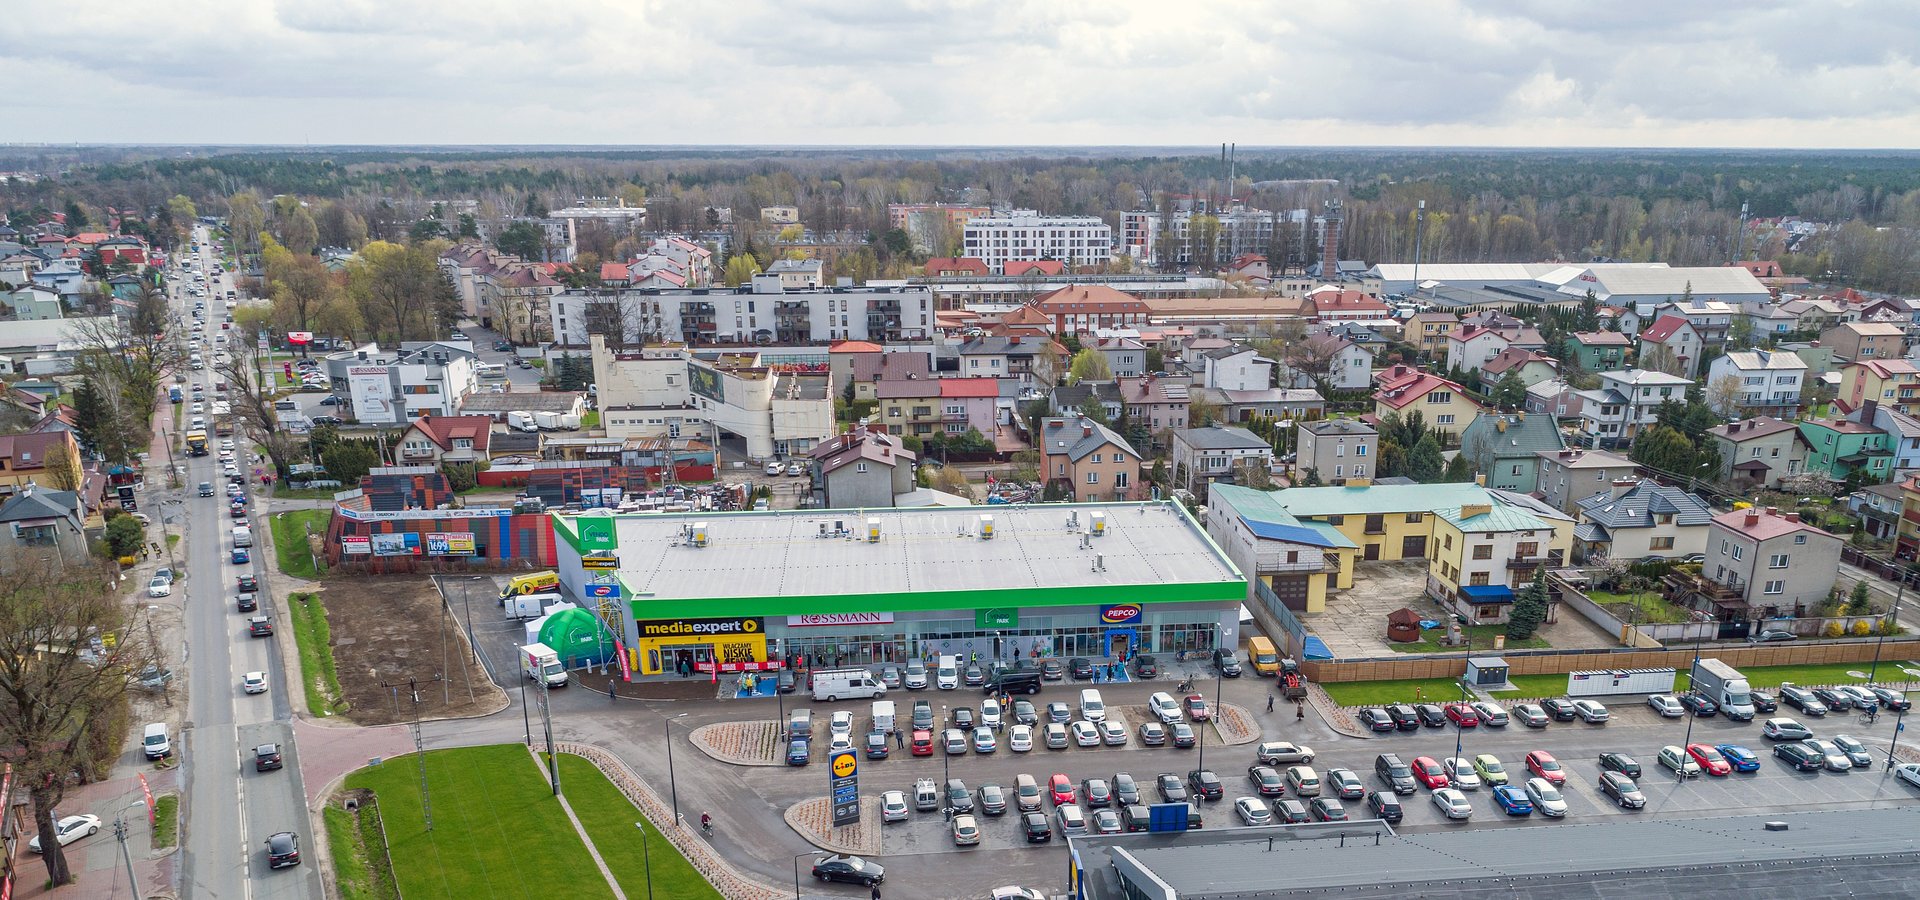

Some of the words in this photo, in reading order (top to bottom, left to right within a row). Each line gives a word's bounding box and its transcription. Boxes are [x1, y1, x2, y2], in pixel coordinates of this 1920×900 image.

[801, 612, 881, 624] ROSSMANN
[1107, 608, 1136, 617] PEPCO
[645, 620, 742, 634] mediaexpert
